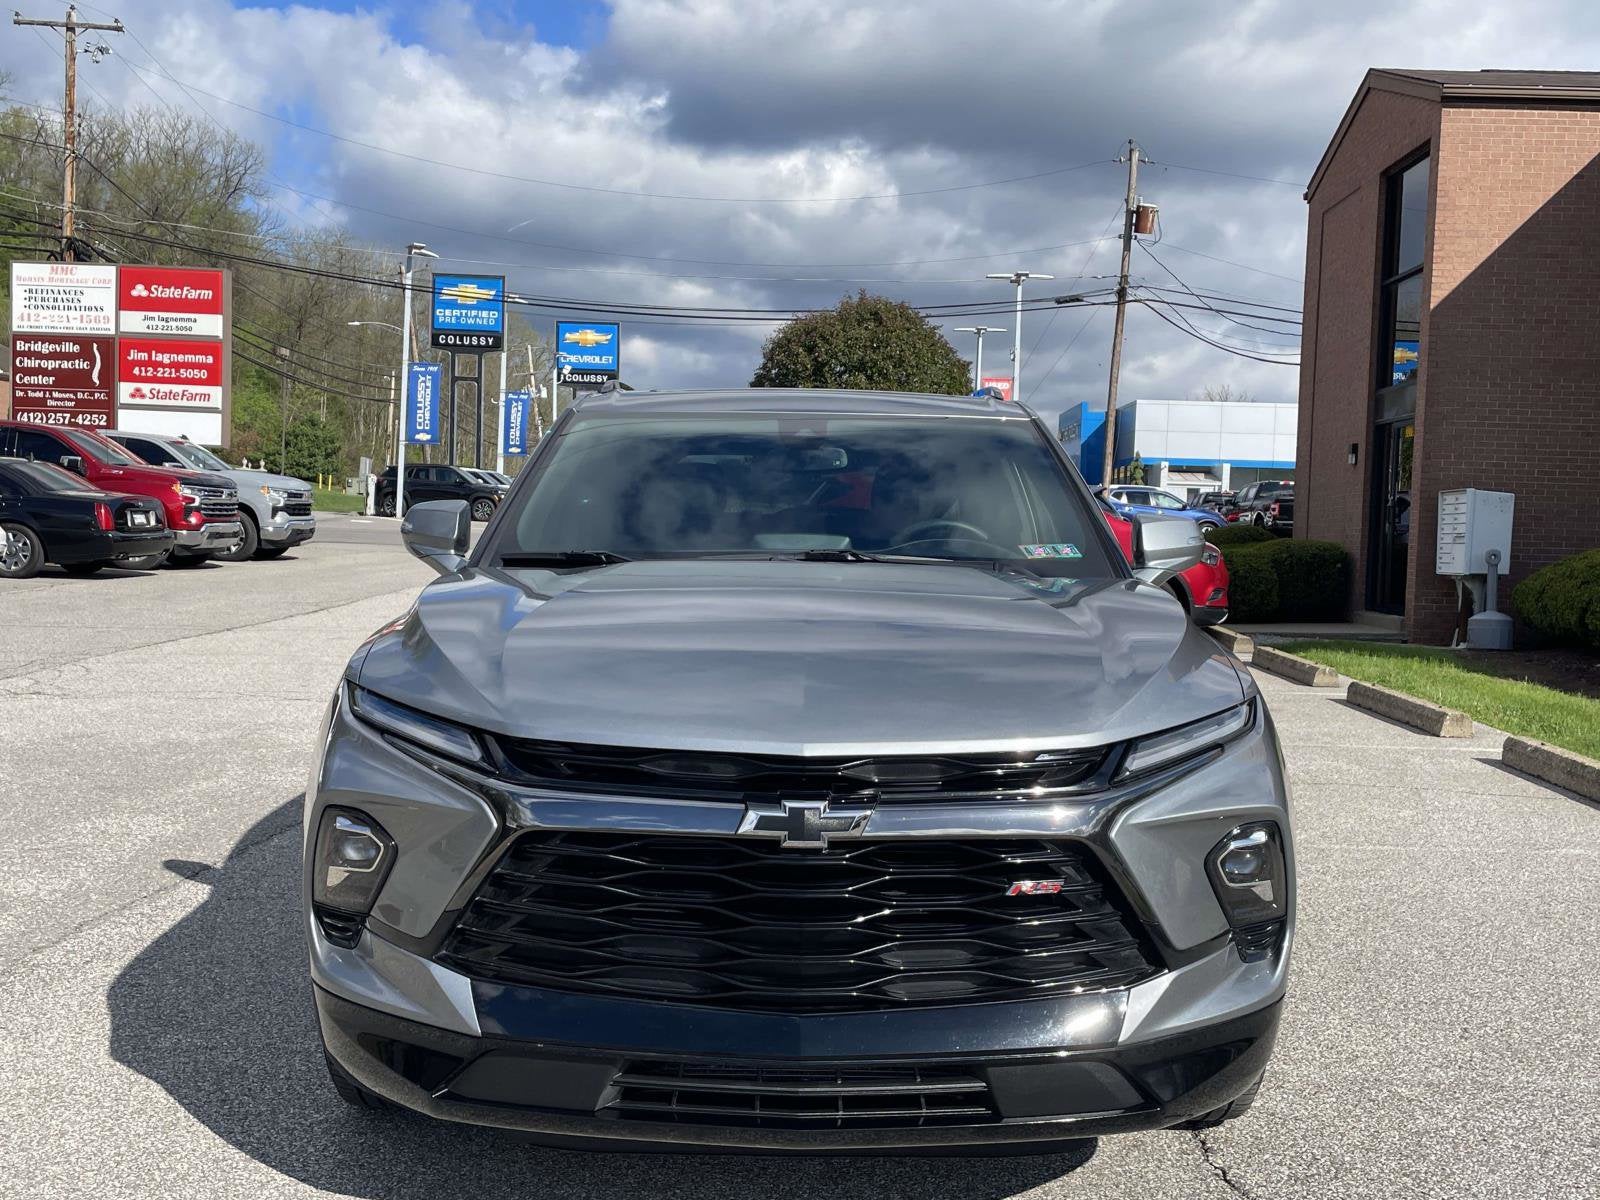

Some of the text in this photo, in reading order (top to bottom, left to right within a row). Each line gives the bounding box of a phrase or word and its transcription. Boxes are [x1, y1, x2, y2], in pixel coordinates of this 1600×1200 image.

[49, 266, 78, 276] MMC
[28, 288, 85, 296] REFINANCES
[28, 295, 82, 304] PURCHASES
[28, 303, 104, 312] CONSOLIDATIONS
[436, 308, 499, 318] CERTIFIED
[142, 314, 156, 322] Jim
[438, 316, 496, 325] PRE-OWNED
[438, 334, 494, 346] COLUSSY
[16, 340, 81, 354] Bridgeville
[126, 349, 214, 364] Jim Iagnemma
[15, 356, 91, 371] Chiropractic
[132, 366, 208, 379] 412-221-5050
[15, 373, 56, 385] Center
[565, 374, 609, 383] COLUSSY
[416, 374, 426, 430] COLUSSY
[1005, 879, 1064, 896] RS
